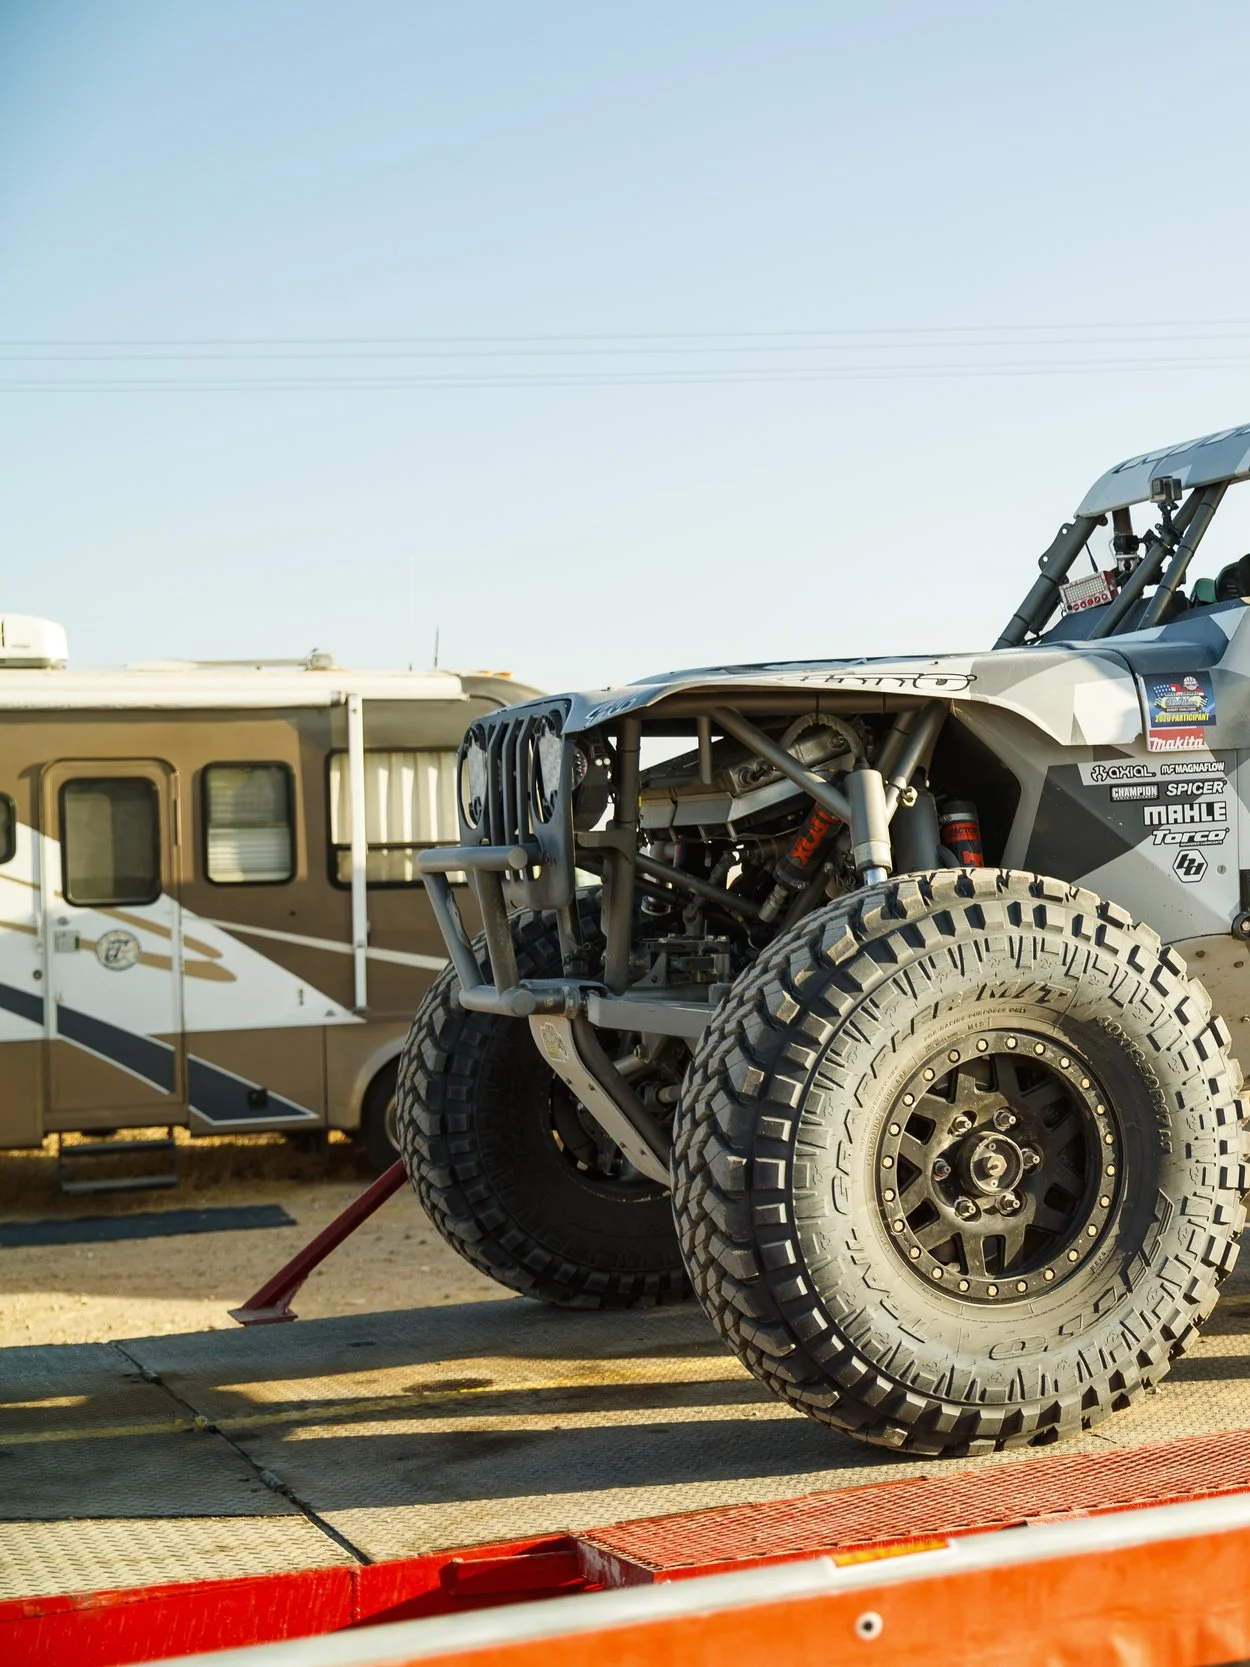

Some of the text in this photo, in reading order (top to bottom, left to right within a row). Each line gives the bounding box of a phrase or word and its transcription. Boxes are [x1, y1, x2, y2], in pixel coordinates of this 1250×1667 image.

[1172, 713, 1209, 722] PARTICIPANT
[1176, 761, 1225, 774] MAGNAFLOW
[1111, 785, 1158, 798] CHAMPION
[1166, 781, 1224, 796] SPICER
[1144, 801, 1227, 826] MAHLE
